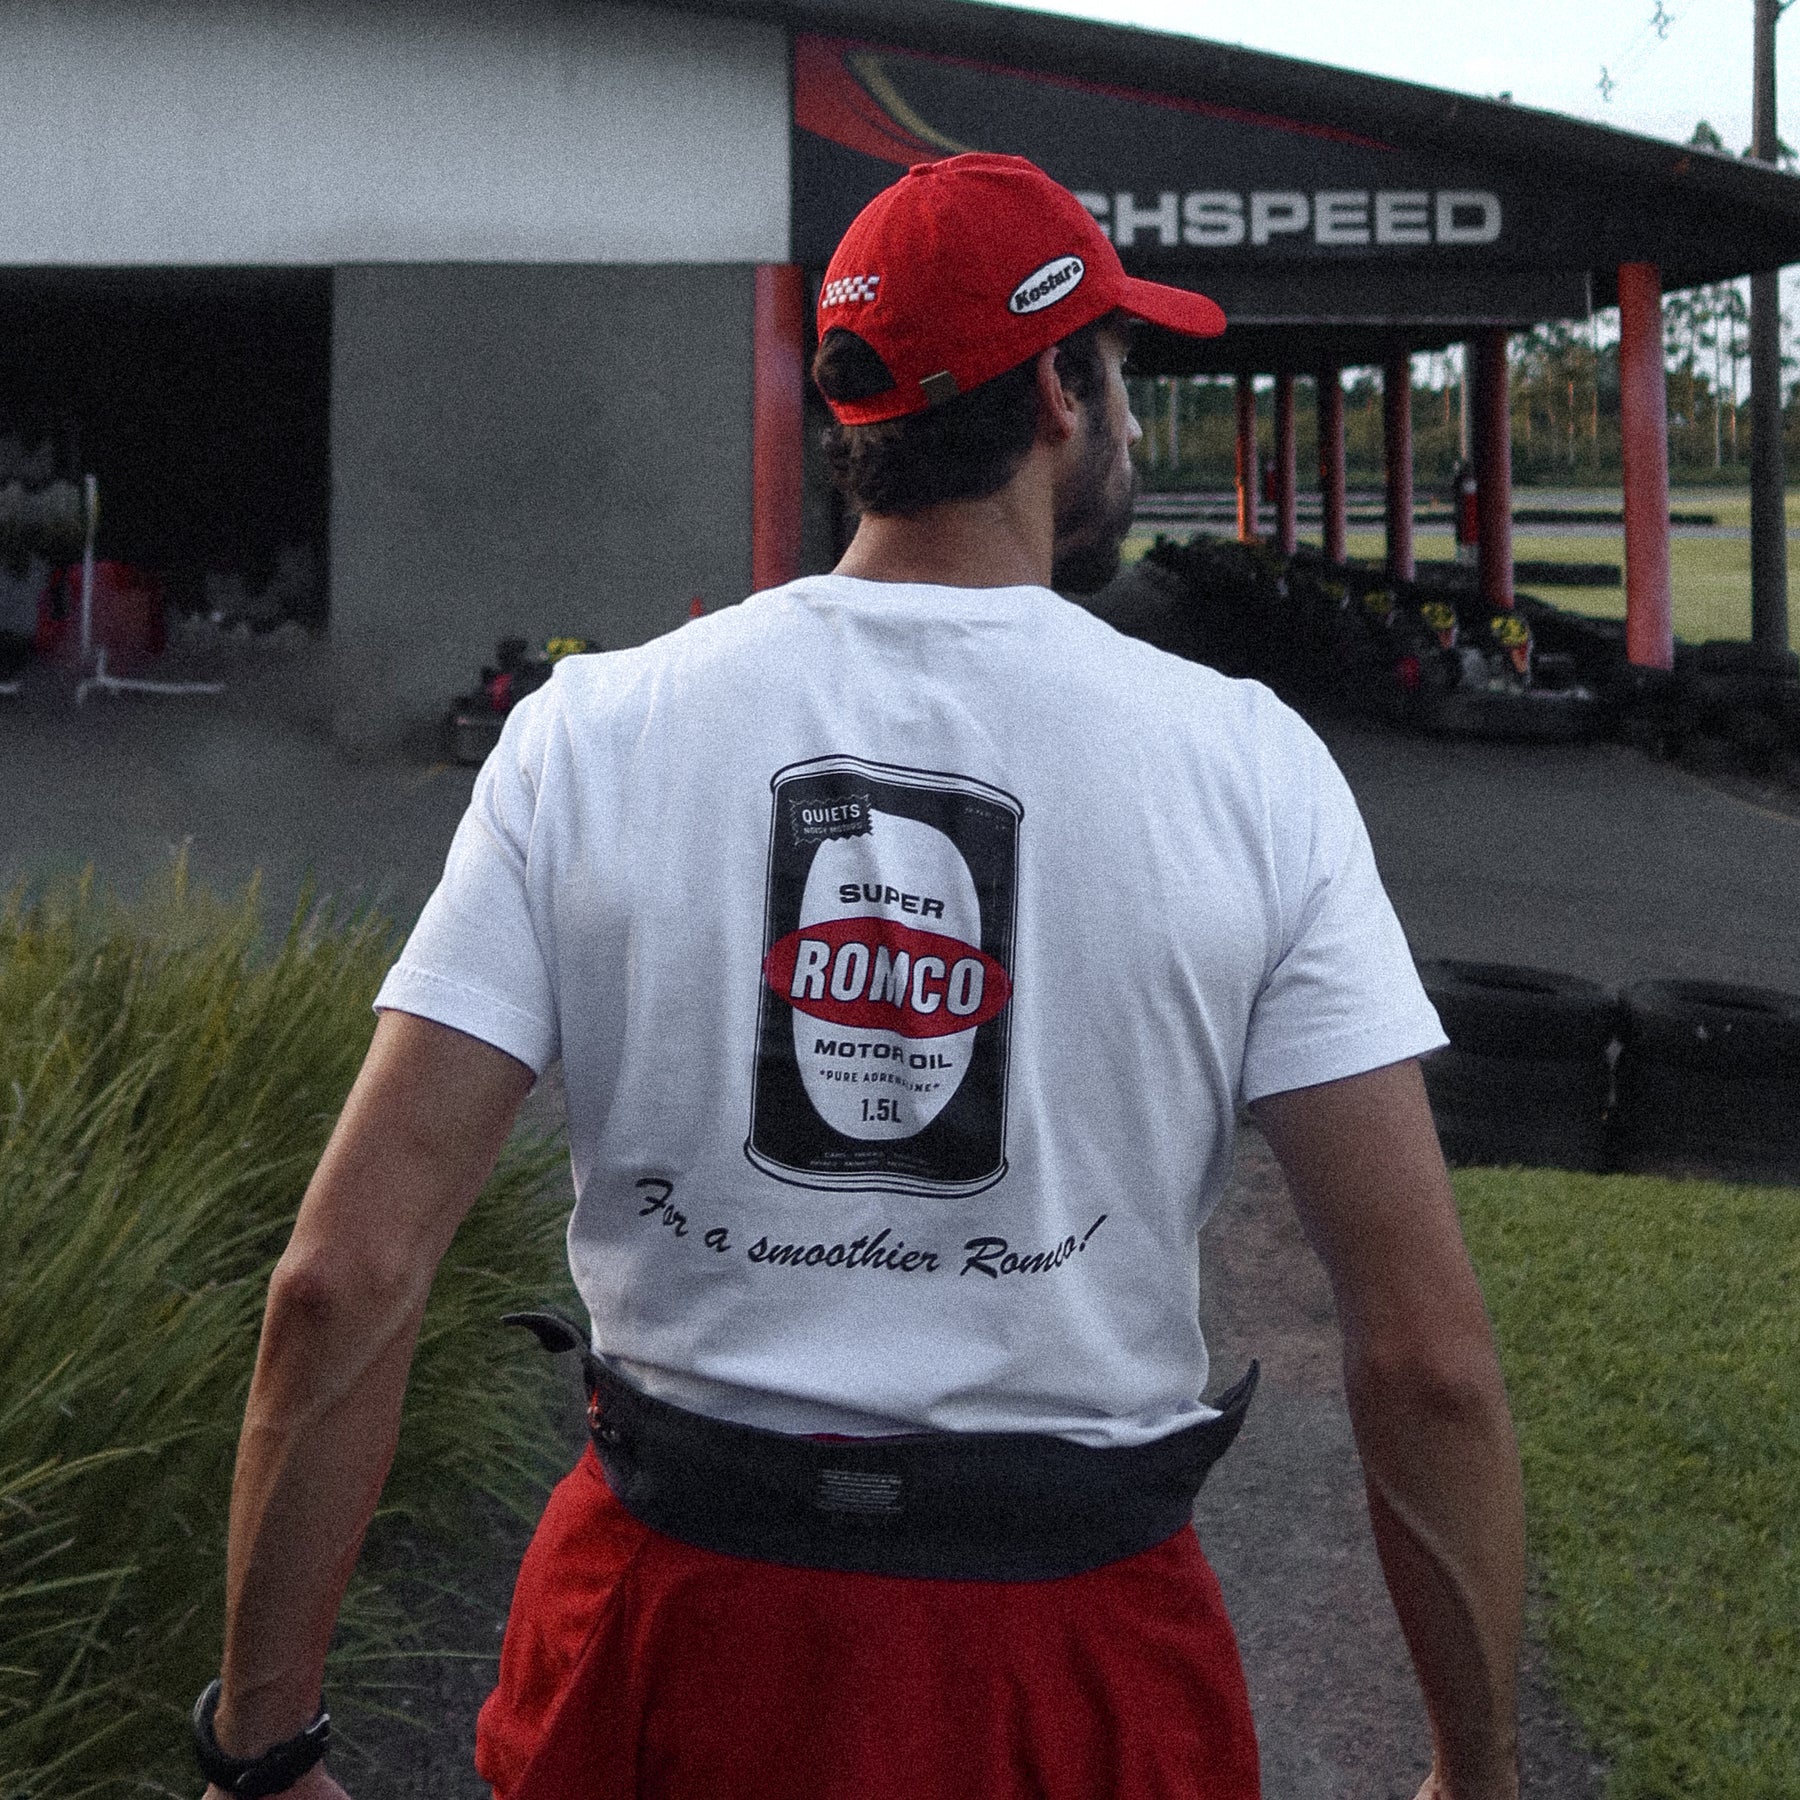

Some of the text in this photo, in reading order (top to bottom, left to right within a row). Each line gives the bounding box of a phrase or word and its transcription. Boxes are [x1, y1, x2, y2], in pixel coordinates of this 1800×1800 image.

[802, 803, 861, 825] QUIETS
[838, 883, 945, 919] SUPER
[789, 938, 985, 1017] ROMCO
[814, 1039, 953, 1070] MOTOR OIL
[861, 1098, 902, 1123] 1.5L
[635, 1177, 688, 1237] For
[704, 1227, 731, 1252] a
[747, 1227, 940, 1273] smoothier
